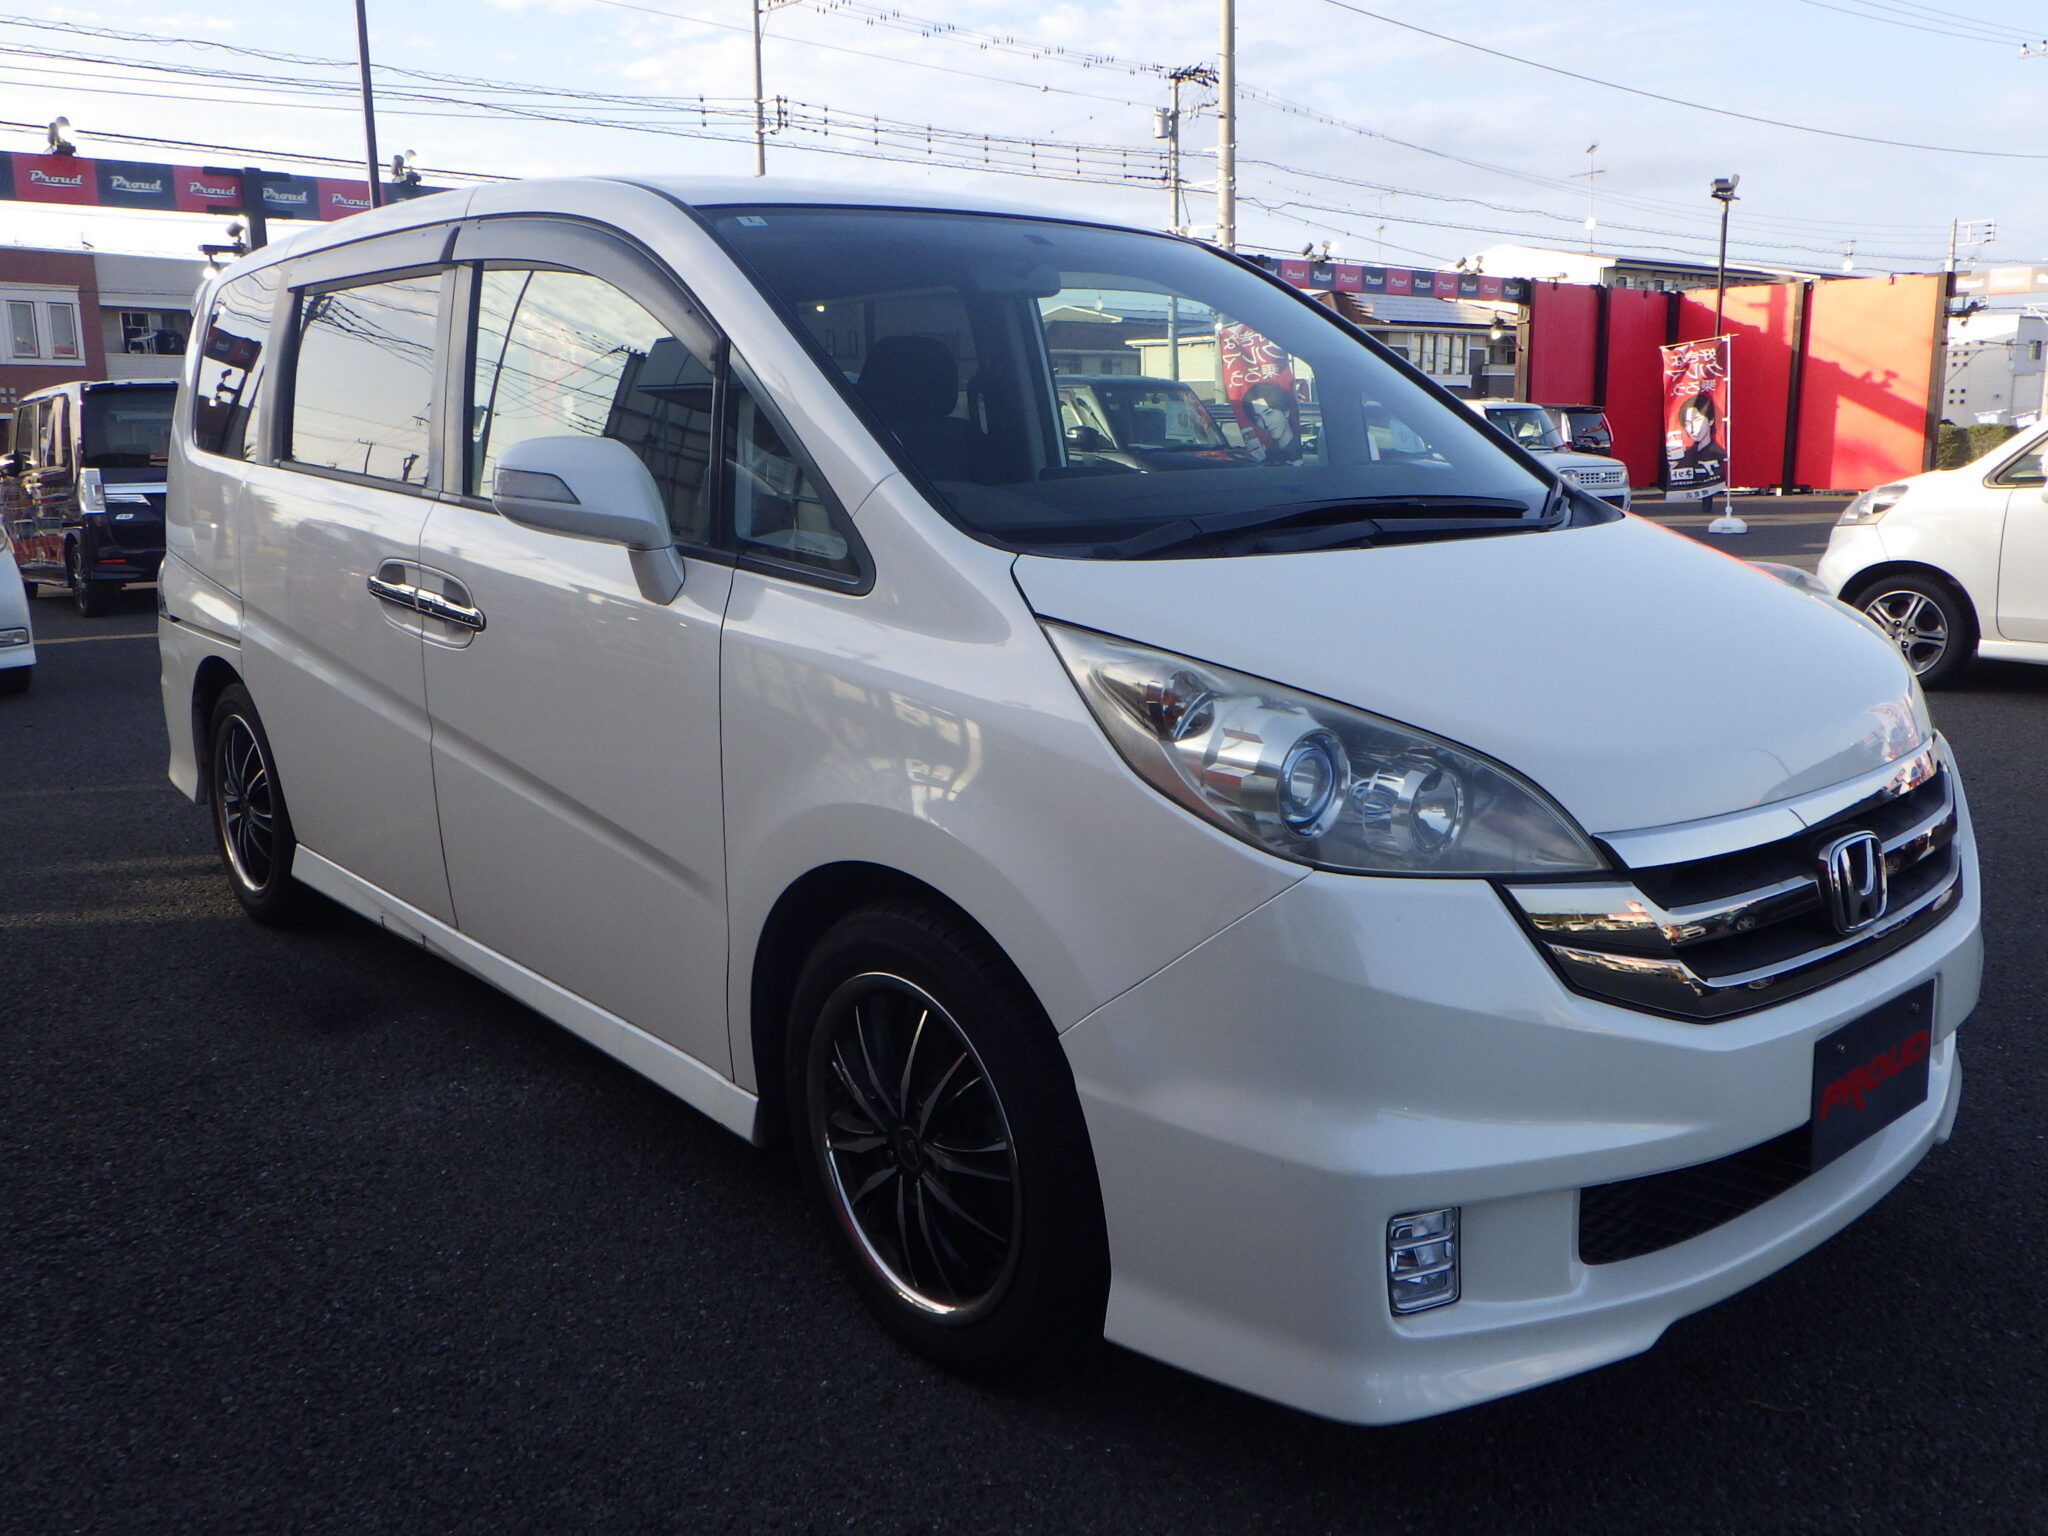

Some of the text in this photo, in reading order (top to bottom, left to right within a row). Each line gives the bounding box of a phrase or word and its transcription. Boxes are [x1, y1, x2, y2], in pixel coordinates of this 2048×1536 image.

[29, 170, 82, 187] Proud
[110, 175, 162, 193] Proud
[189, 182, 237, 198] Proud
[262, 187, 308, 204] Proud
[1819, 1029, 1929, 1121] PROUD
